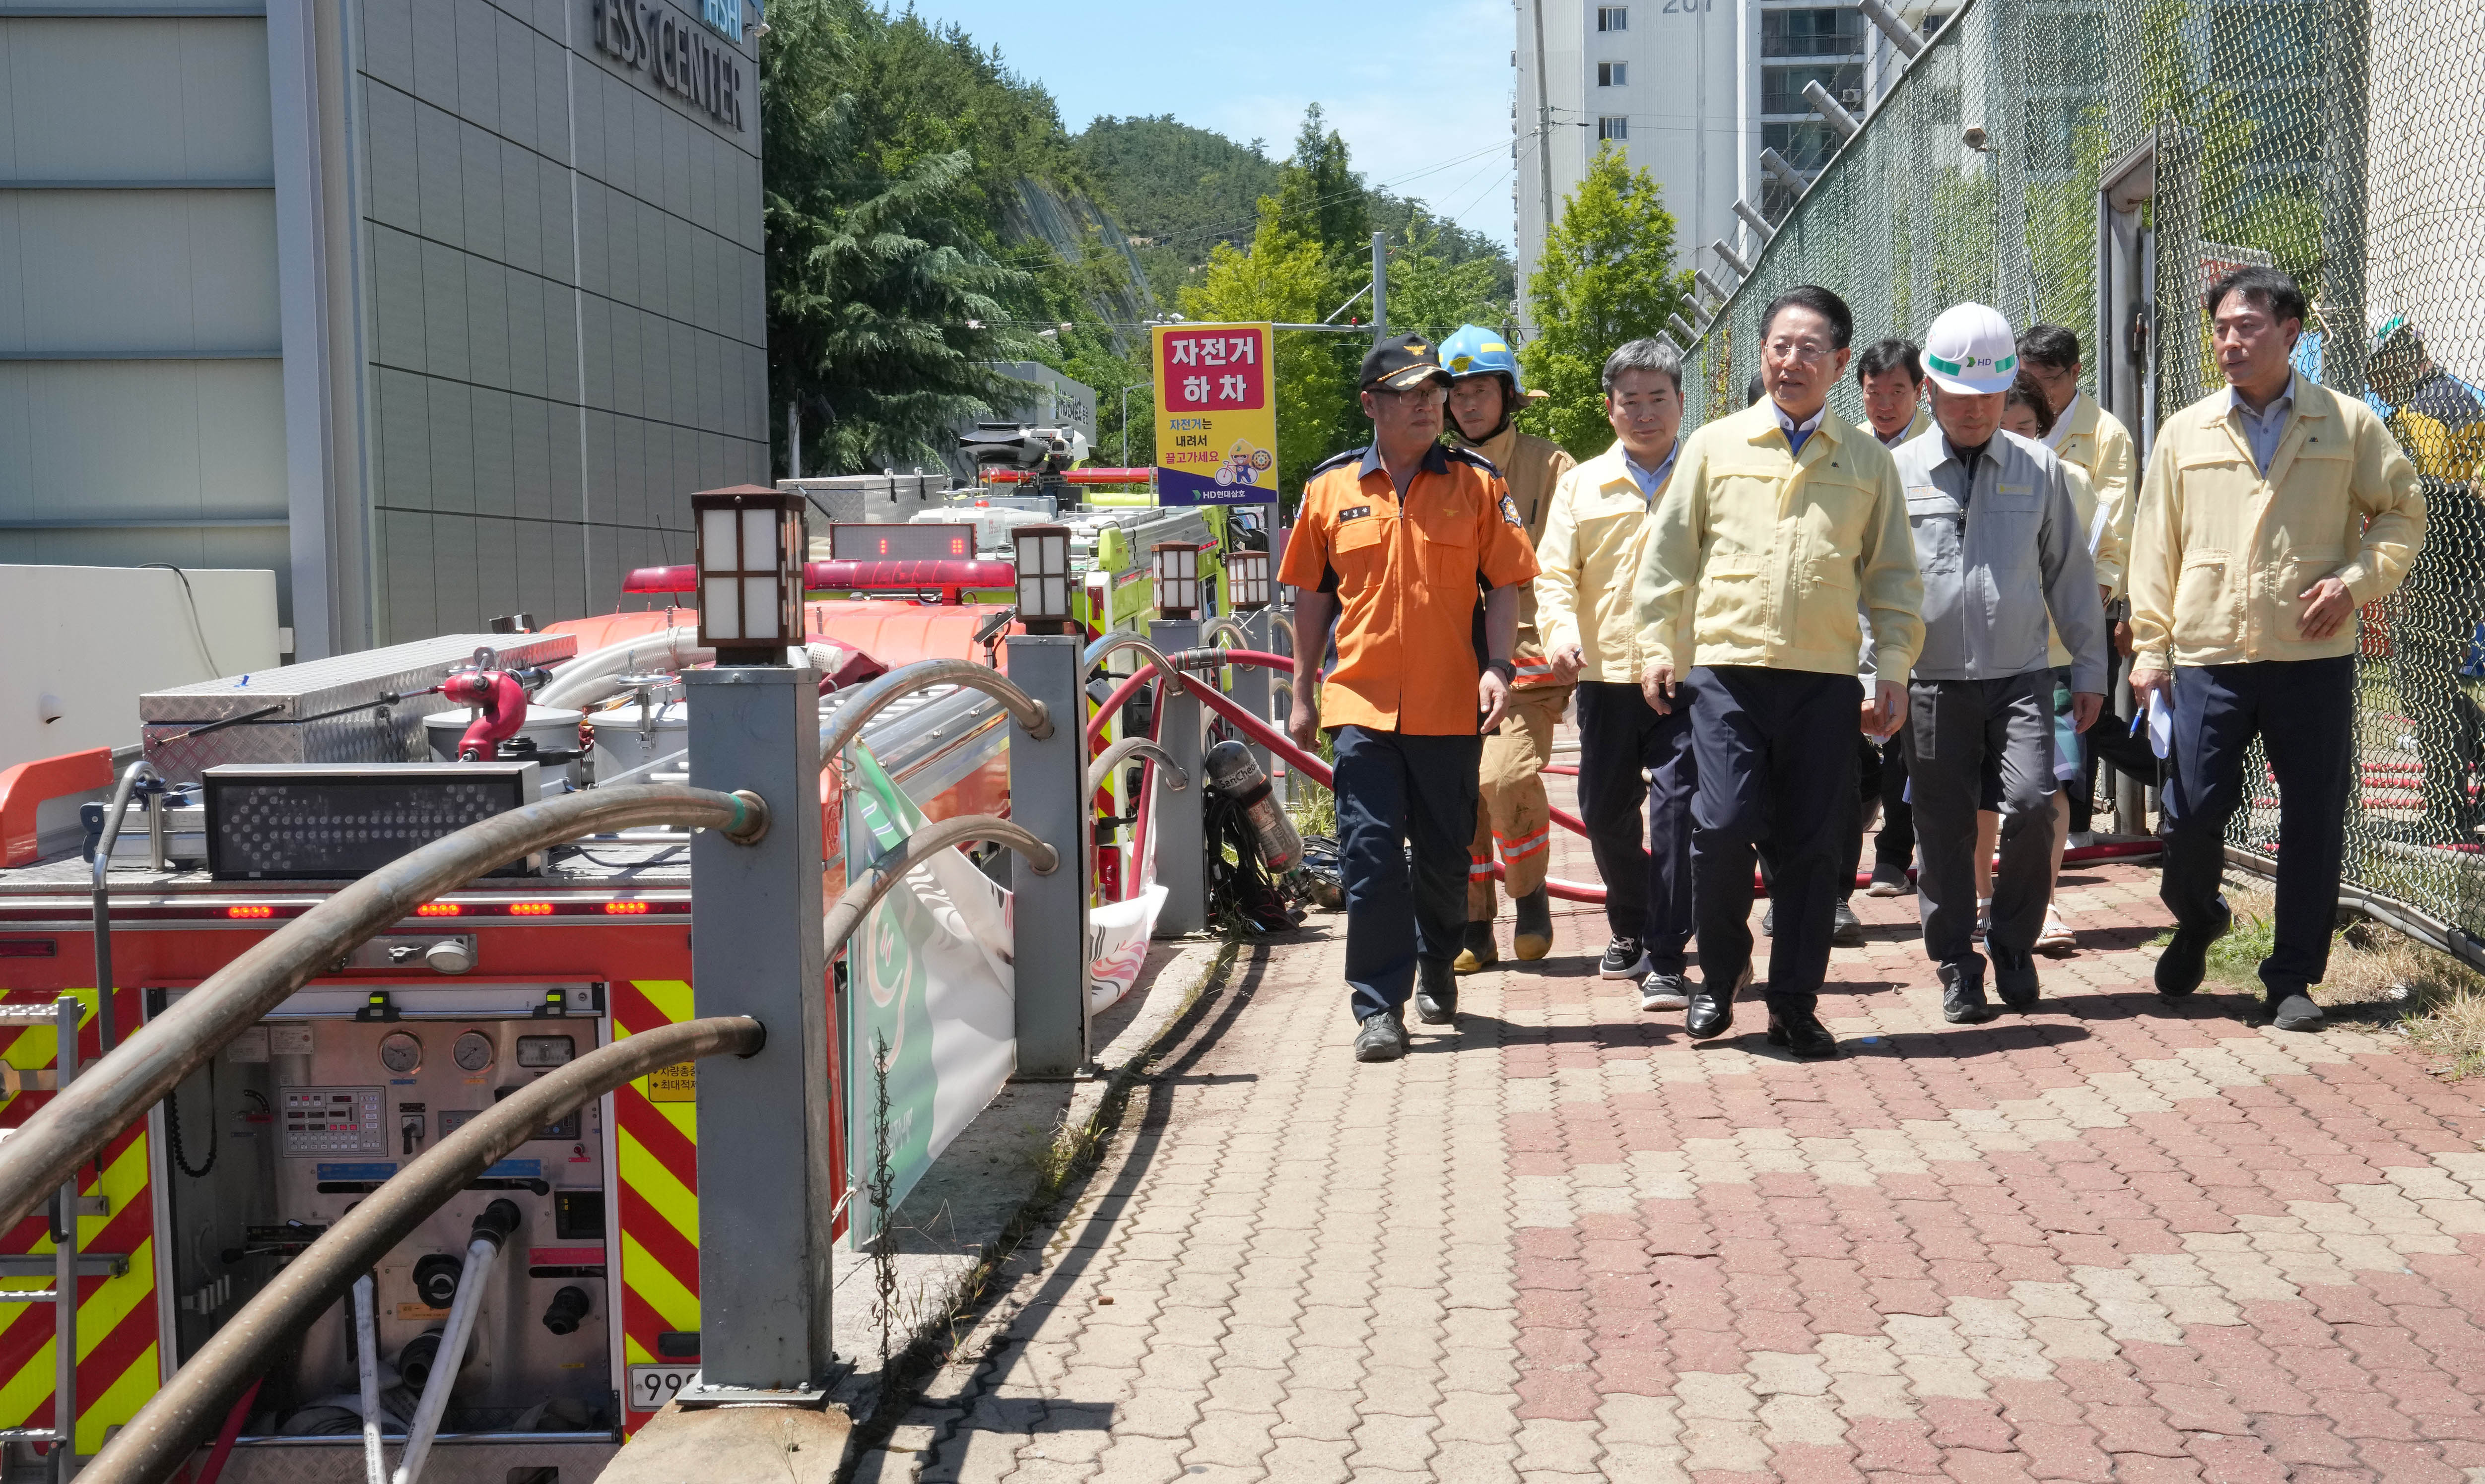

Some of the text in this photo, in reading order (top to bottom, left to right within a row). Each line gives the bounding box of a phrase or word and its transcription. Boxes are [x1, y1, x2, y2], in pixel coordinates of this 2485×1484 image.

[654, 9, 745, 132] CENTER
[1171, 336, 1255, 367] 자전거
[1169, 418, 1212, 431] 자전거는
[1176, 435, 1207, 447] 내려서
[1165, 451, 1219, 464] 끌고가세요
[1203, 489, 1245, 499] HD현대삼호
